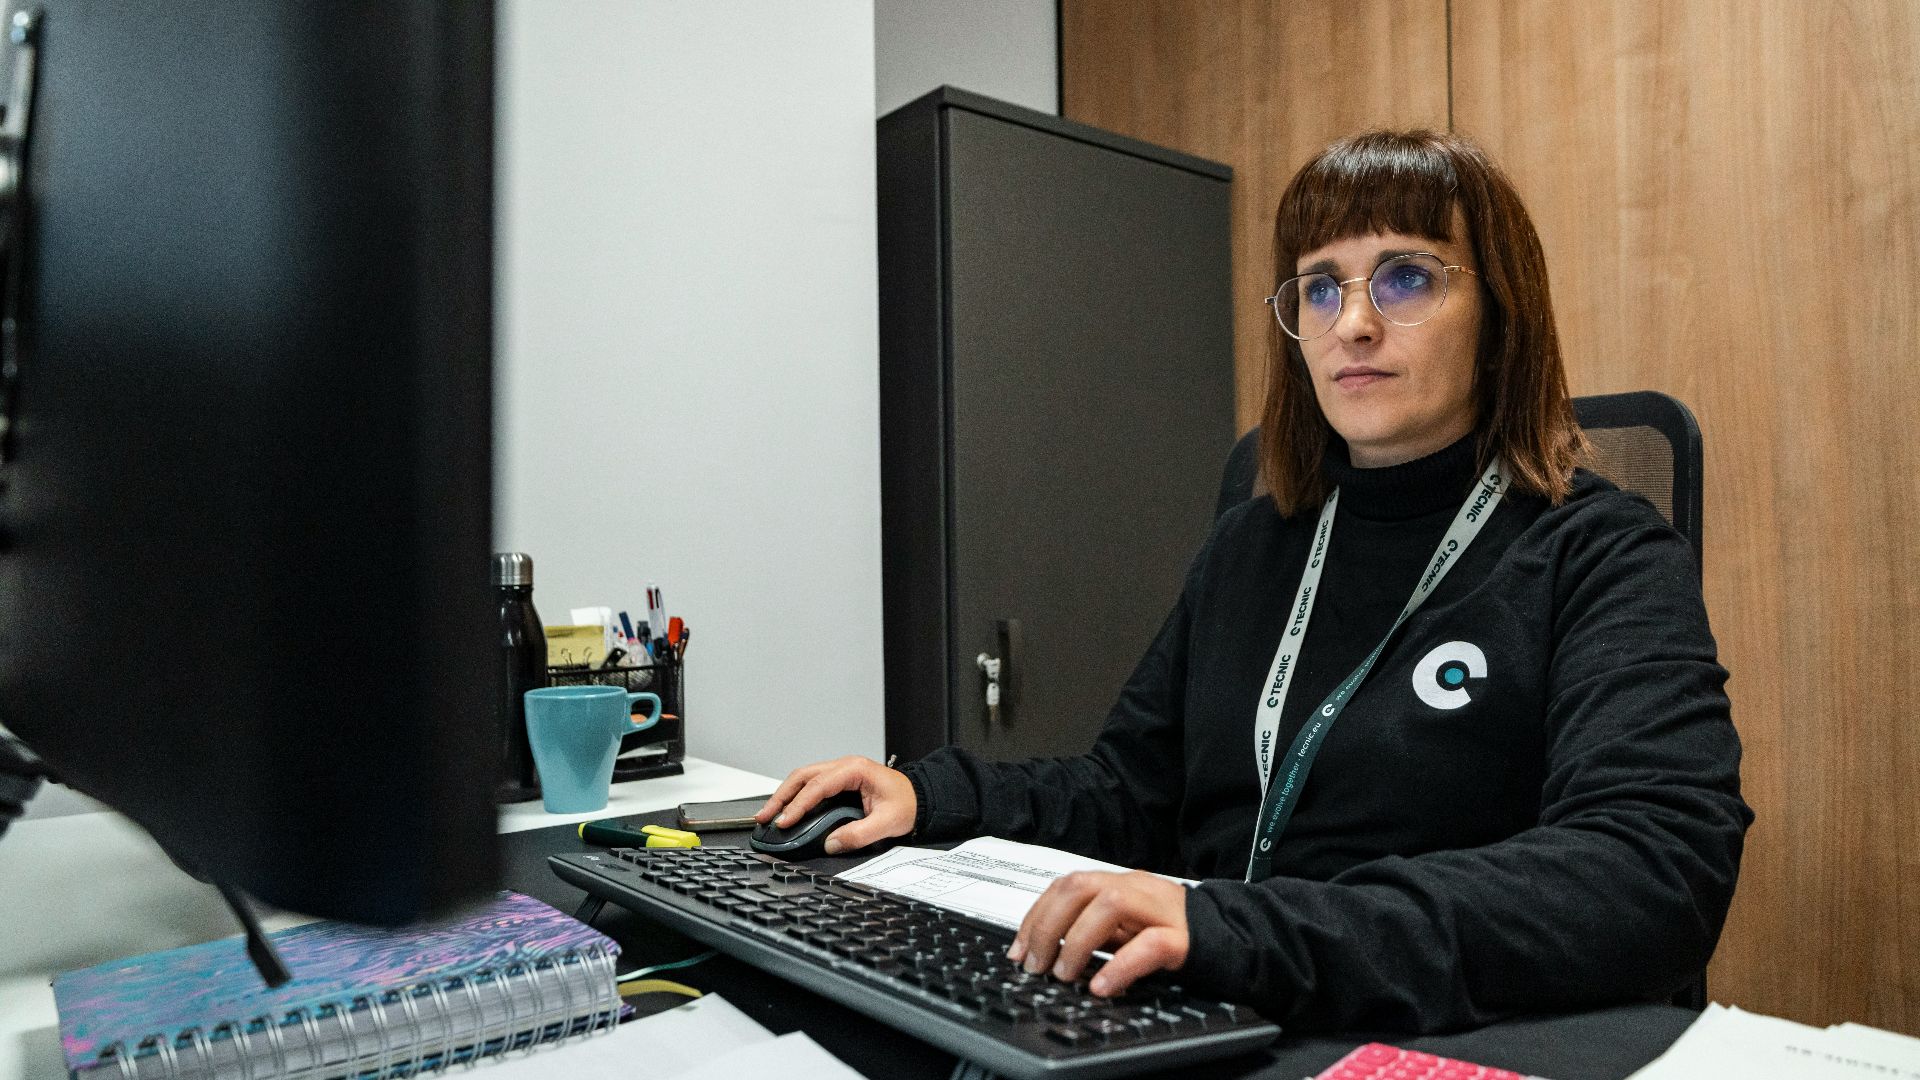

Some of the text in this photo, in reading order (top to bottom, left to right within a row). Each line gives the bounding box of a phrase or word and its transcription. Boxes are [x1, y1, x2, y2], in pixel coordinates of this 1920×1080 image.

[1466, 484, 1497, 523] TECNIC
[1314, 519, 1329, 559] TECNIC
[1421, 550, 1451, 593] TECNIC
[1294, 586, 1312, 627] TECNIC
[1270, 654, 1292, 696] TECNIC
[1267, 722, 1322, 833] we evolve together tecnic.eu
